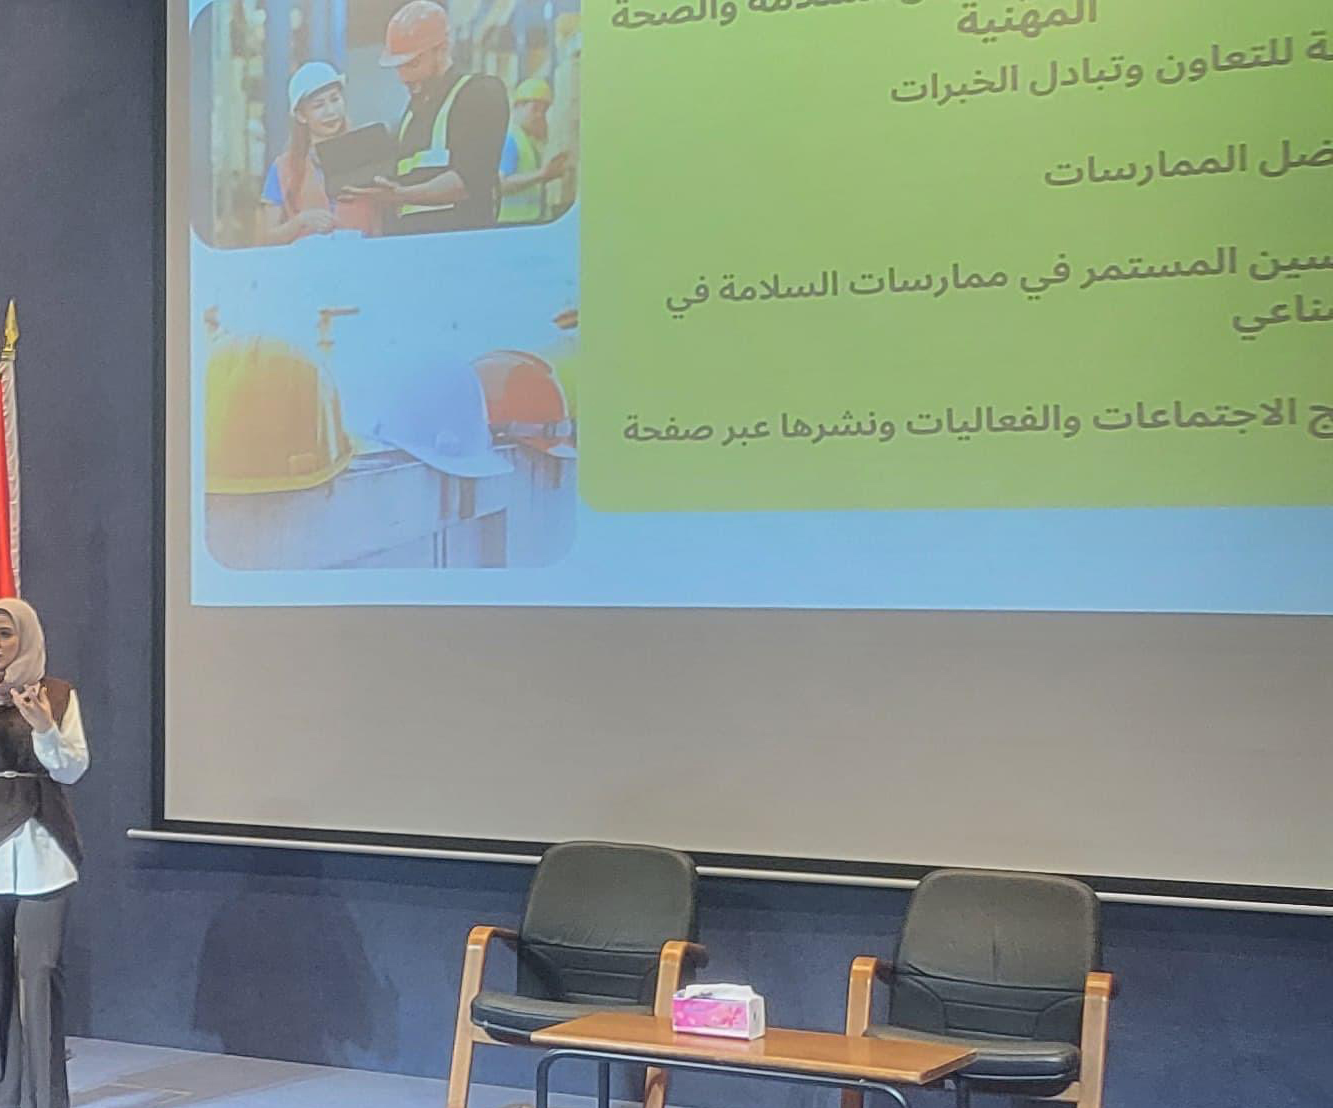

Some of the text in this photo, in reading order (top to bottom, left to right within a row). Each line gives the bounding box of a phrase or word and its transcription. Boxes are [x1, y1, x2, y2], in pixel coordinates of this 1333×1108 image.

[956, 0, 1098, 43] المهنية
[1029, 55, 1144, 96] وتبادل
[1155, 36, 1294, 84] للتعاون
[890, 64, 1018, 105] الخبرات
[1044, 143, 1247, 187] الممارسات
[719, 270, 839, 302] السلامة
[849, 263, 1008, 297] ممارسات
[1020, 253, 1071, 300] في
[1079, 246, 1237, 289] المستمر
[666, 275, 710, 319] في
[623, 414, 714, 441] صفحة
[722, 419, 770, 447] عبر
[781, 410, 896, 444] ونشرها
[906, 403, 1081, 440] والفعاليات
[1093, 398, 1296, 434] الاجتماعات
